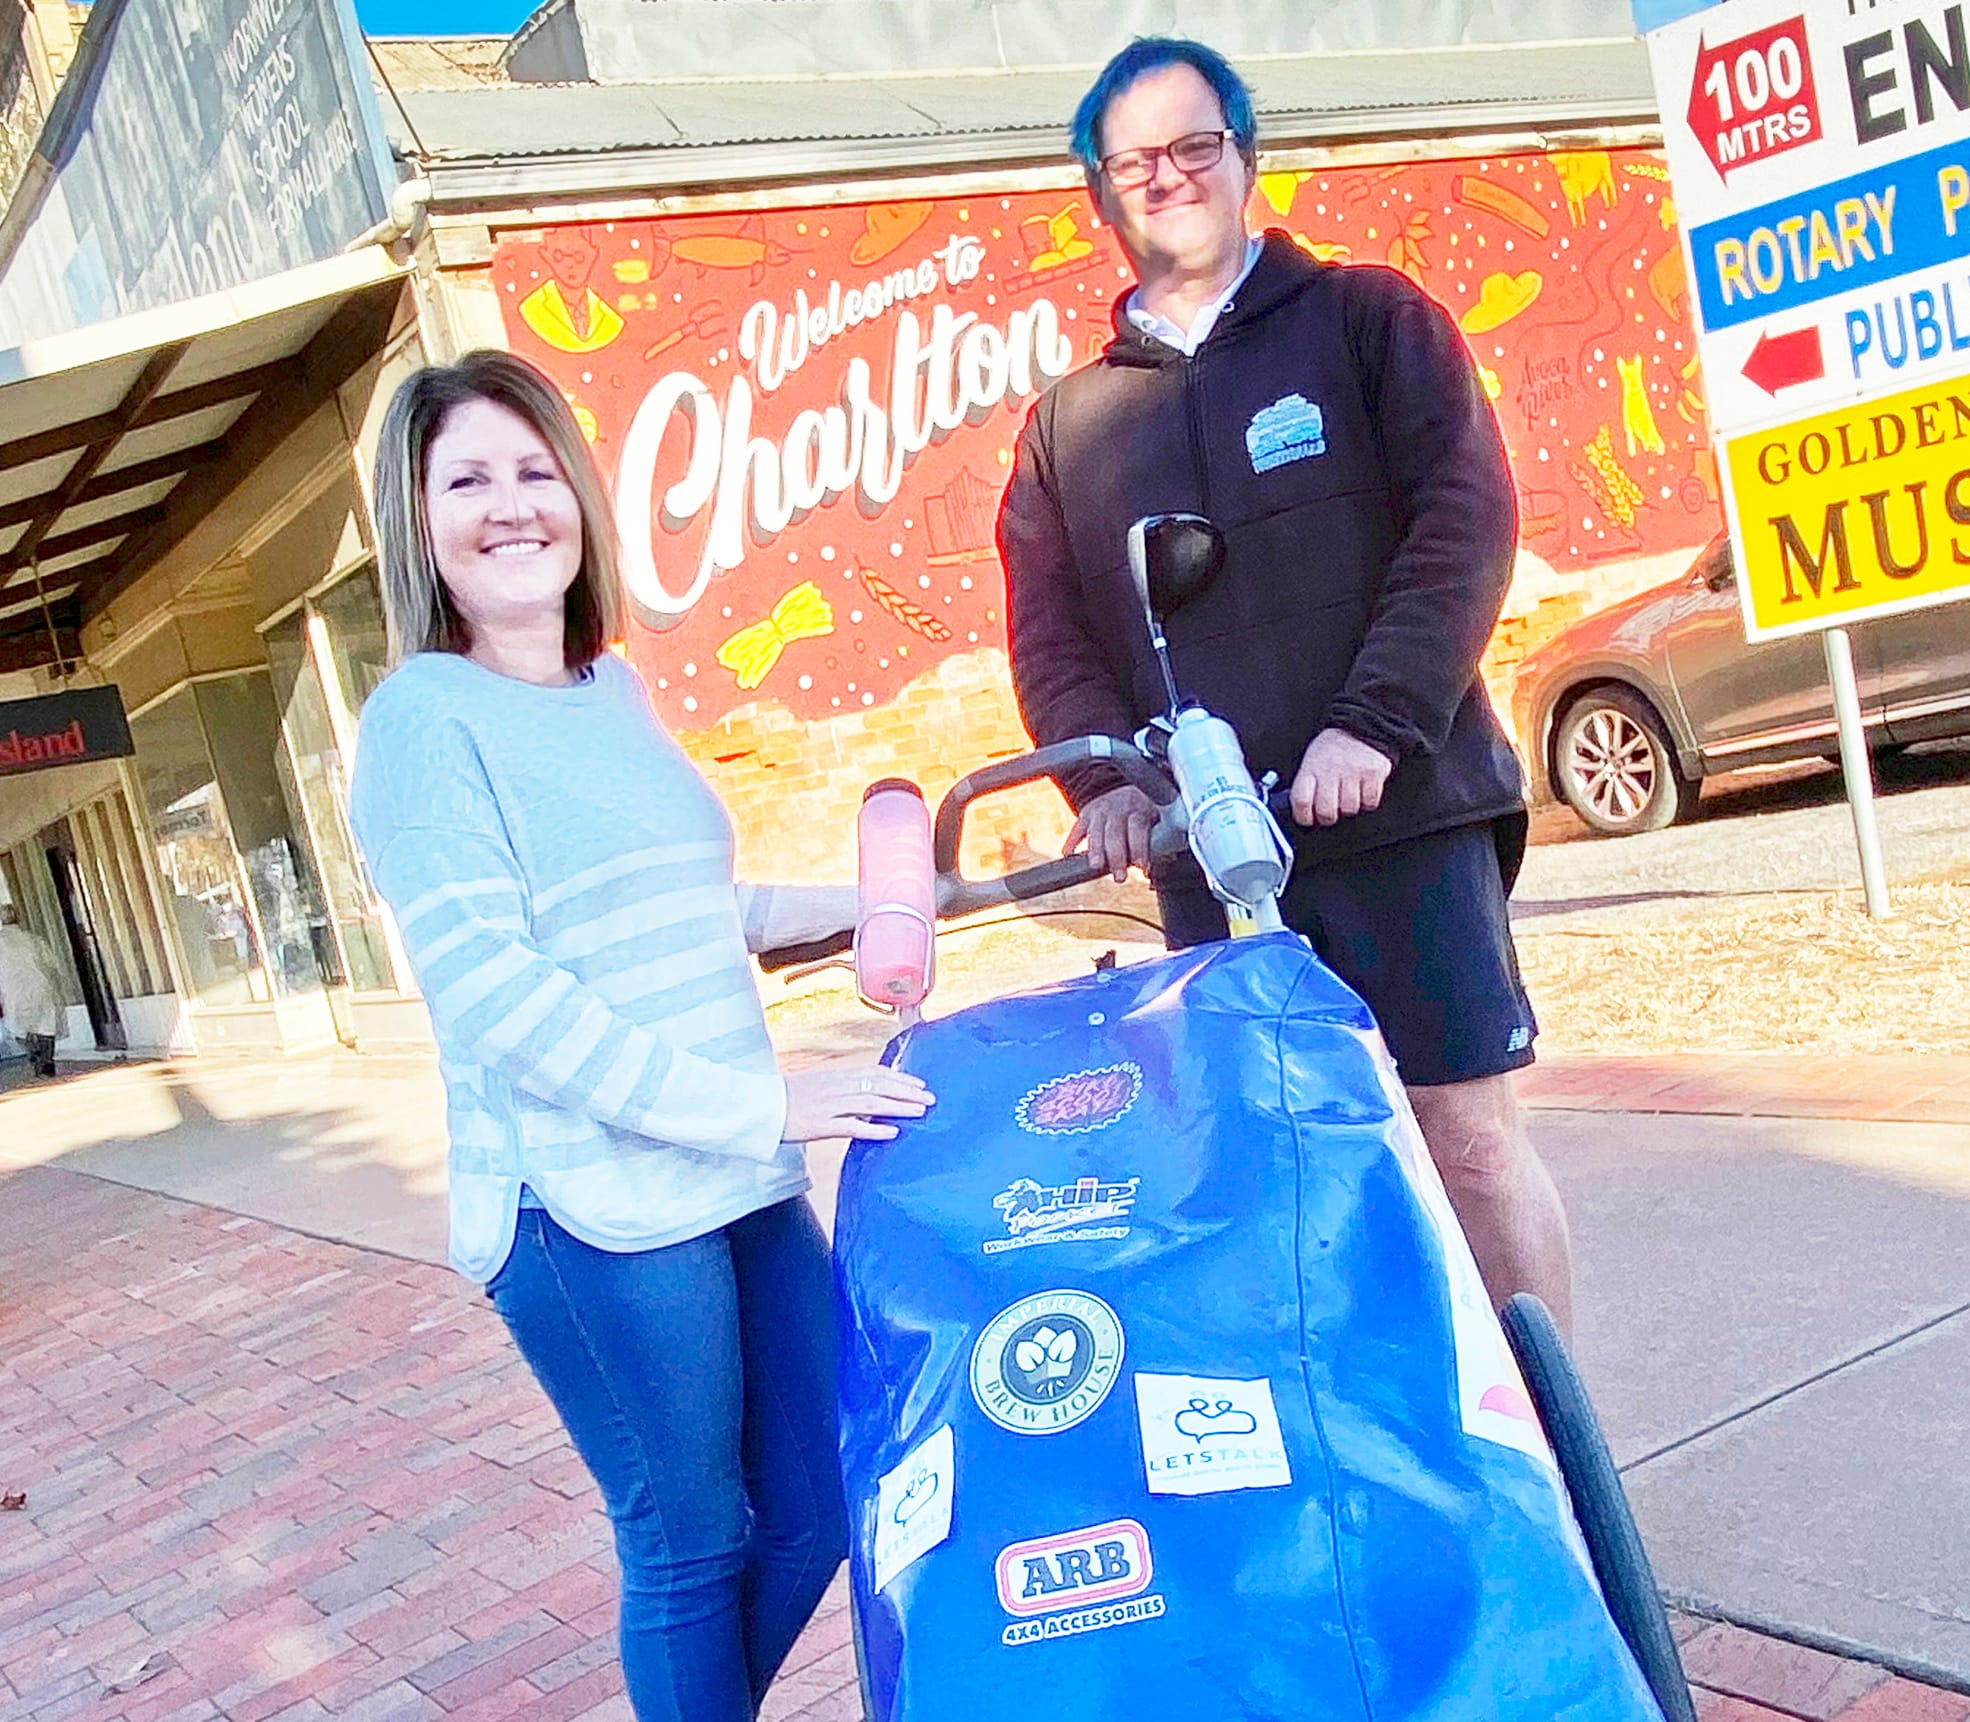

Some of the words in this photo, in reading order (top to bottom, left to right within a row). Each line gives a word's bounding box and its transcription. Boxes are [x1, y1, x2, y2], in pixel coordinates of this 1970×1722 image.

[239, 35, 296, 140] WOMENS
[1705, 36, 1802, 122] 100
[253, 95, 311, 194] SCHOOL
[1717, 104, 1811, 164] MTRS
[266, 151, 325, 249] FORMAL
[1714, 185, 1896, 306] ROTARY
[739, 259, 939, 391] Welcome
[932, 233, 986, 286] to
[617, 299, 1073, 615] Charlton
[989, 1295, 1102, 1342] IMPERIAL
[985, 1379, 1042, 1423] BREW
[1052, 1349, 1115, 1422] HOUSE
[1022, 1541, 1130, 1598] ARB
[1047, 1600, 1161, 1634] ACCESSORIES
